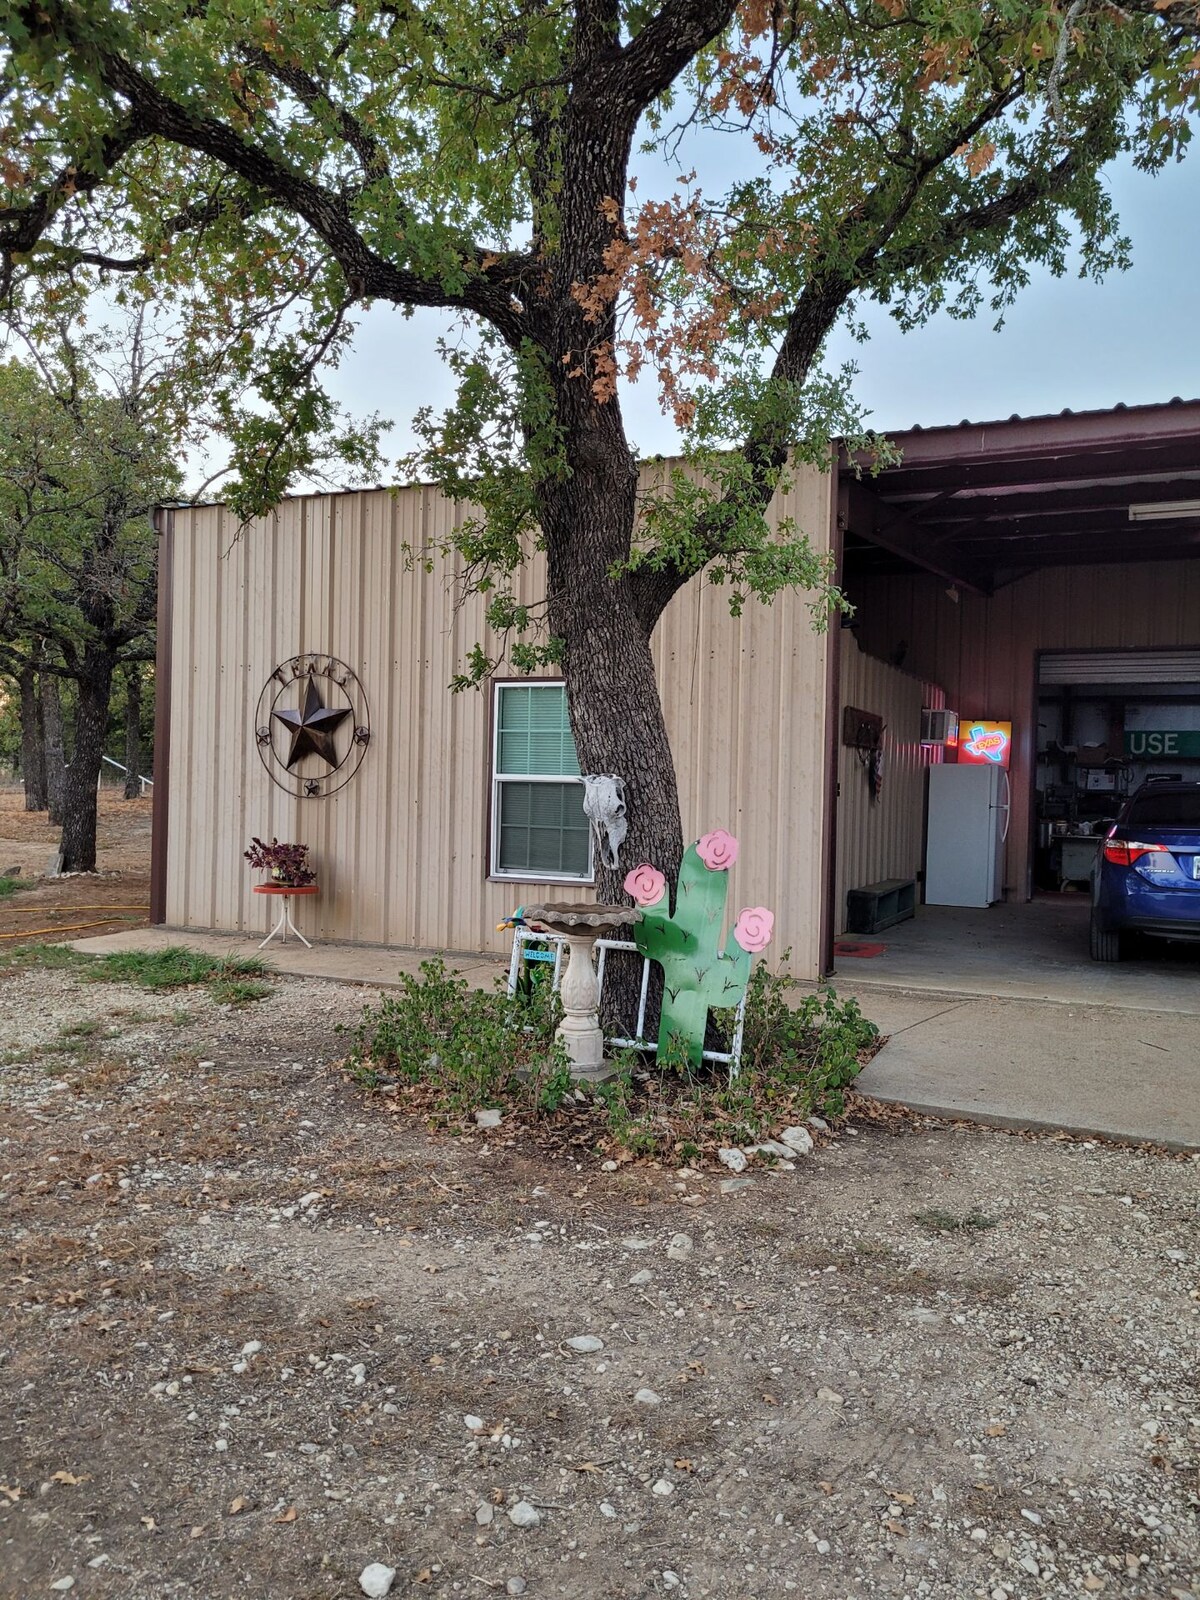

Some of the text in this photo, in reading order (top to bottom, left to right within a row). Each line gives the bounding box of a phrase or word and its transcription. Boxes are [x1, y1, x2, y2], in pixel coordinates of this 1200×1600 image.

[272, 655, 354, 688] TEXAS
[973, 736, 1001, 750] TEXAS
[1130, 733, 1179, 755] USE
[525, 951, 555, 961] WELCOME
